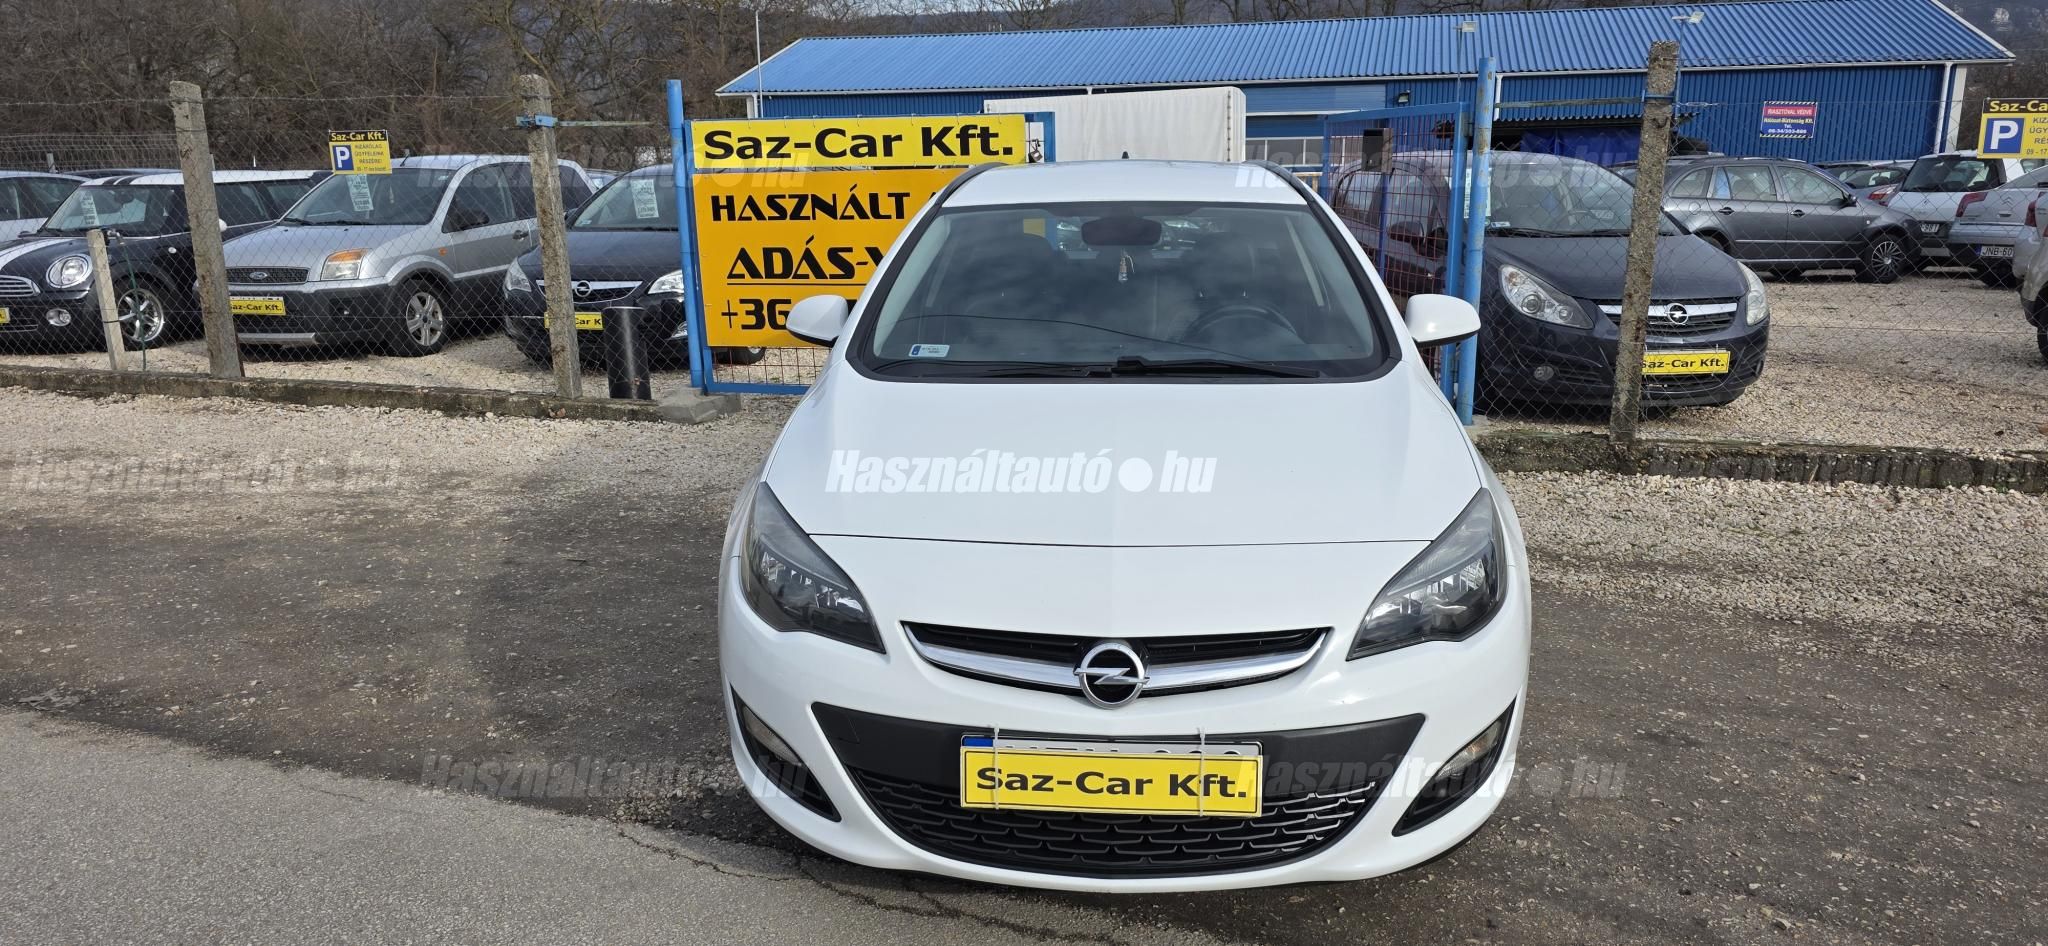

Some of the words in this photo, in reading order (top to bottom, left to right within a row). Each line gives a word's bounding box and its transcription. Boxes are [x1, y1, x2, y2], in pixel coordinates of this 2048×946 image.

[1989, 100, 2048, 112] Saz-Ca
[2033, 116, 2048, 124] KIZ
[331, 132, 366, 141] Saz-Car
[367, 131, 385, 140] Kft.
[1990, 120, 2019, 150] P
[703, 127, 903, 160] Saz-Car
[920, 124, 1014, 157] Kft.
[335, 146, 350, 169] P
[710, 184, 911, 221] HASZNÁLT
[1982, 247, 2013, 257] JNB-60
[231, 303, 263, 311] az-Car
[265, 303, 282, 311] Kft.
[1641, 359, 1696, 369] Saz-Car
[1700, 358, 1724, 367] Kft.
[976, 766, 1153, 796] Saz-Car
[1168, 774, 1247, 798] Kft.
